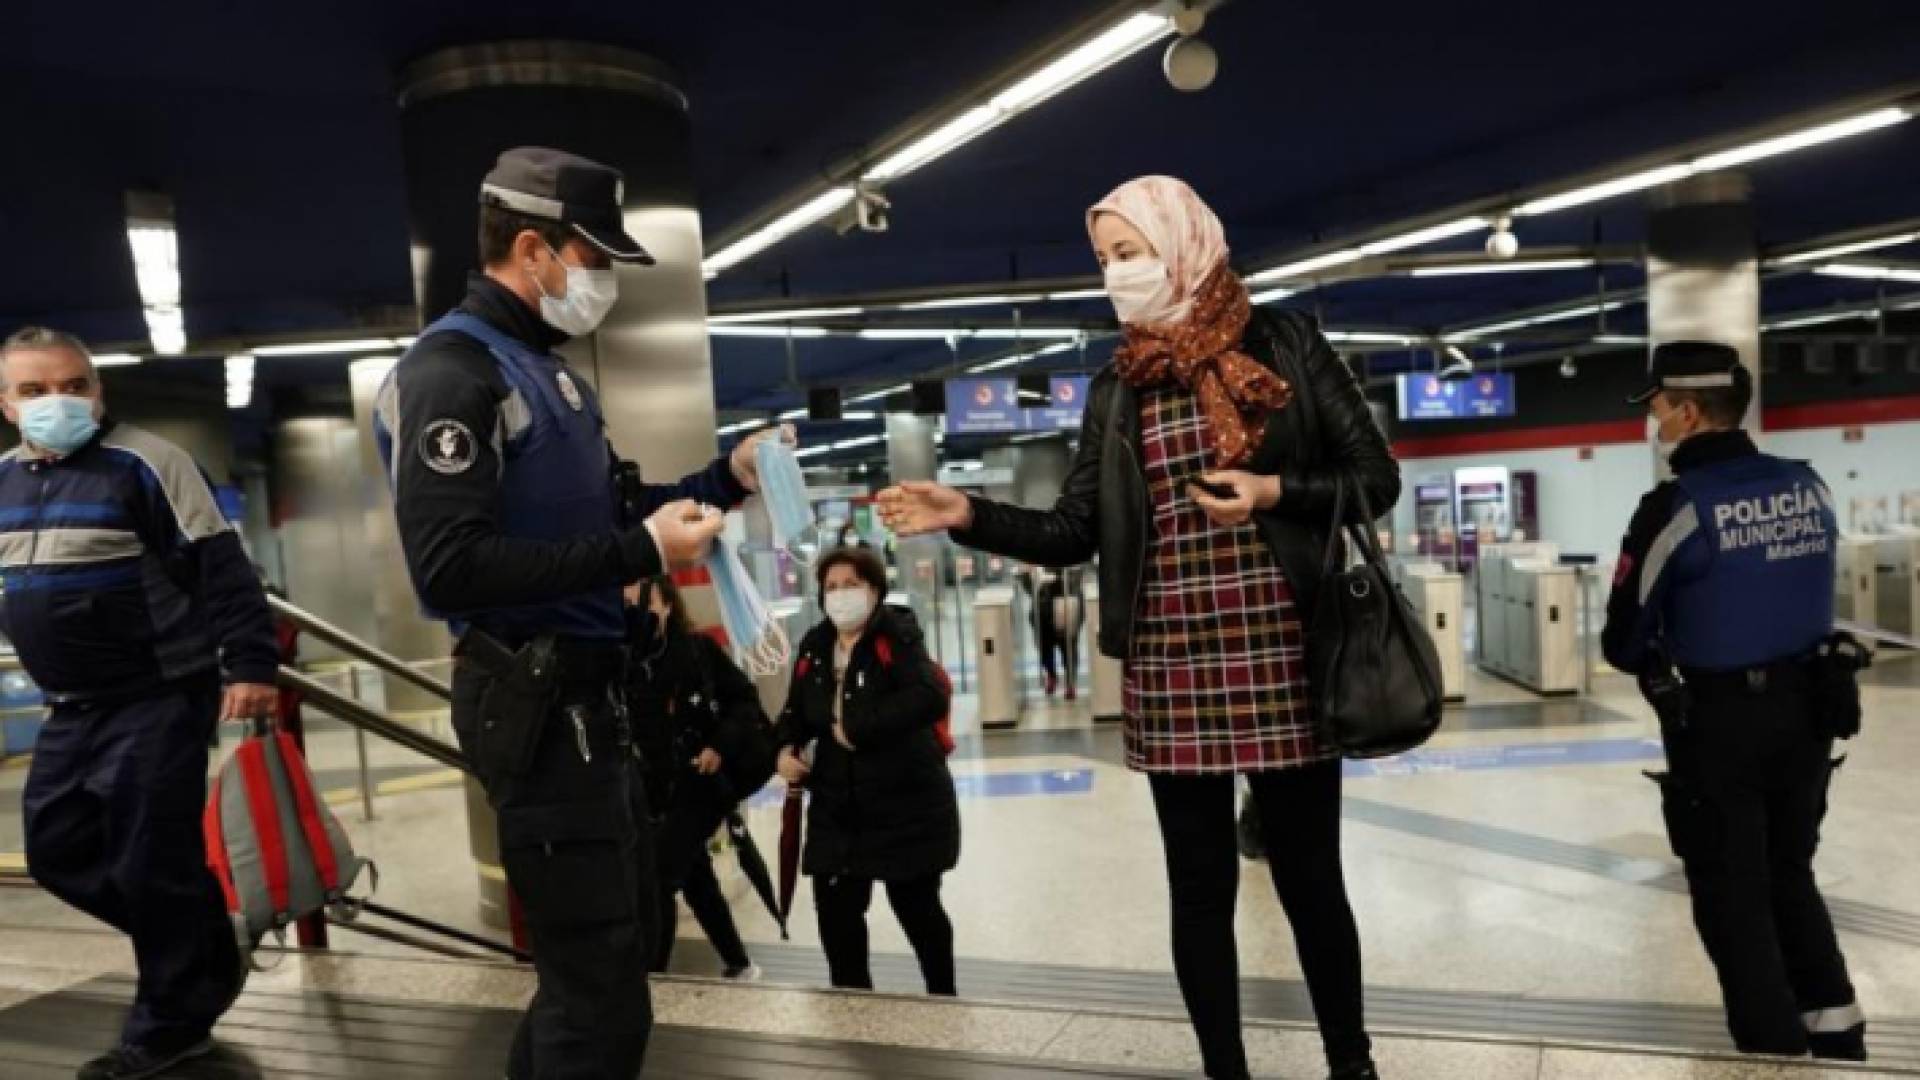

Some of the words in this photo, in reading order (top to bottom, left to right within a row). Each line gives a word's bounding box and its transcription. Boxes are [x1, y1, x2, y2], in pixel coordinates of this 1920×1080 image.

[1714, 482, 1819, 528] POLICÍA
[1719, 515, 1825, 550] MUNICIPAL
[1766, 540, 1825, 560] Madrid
